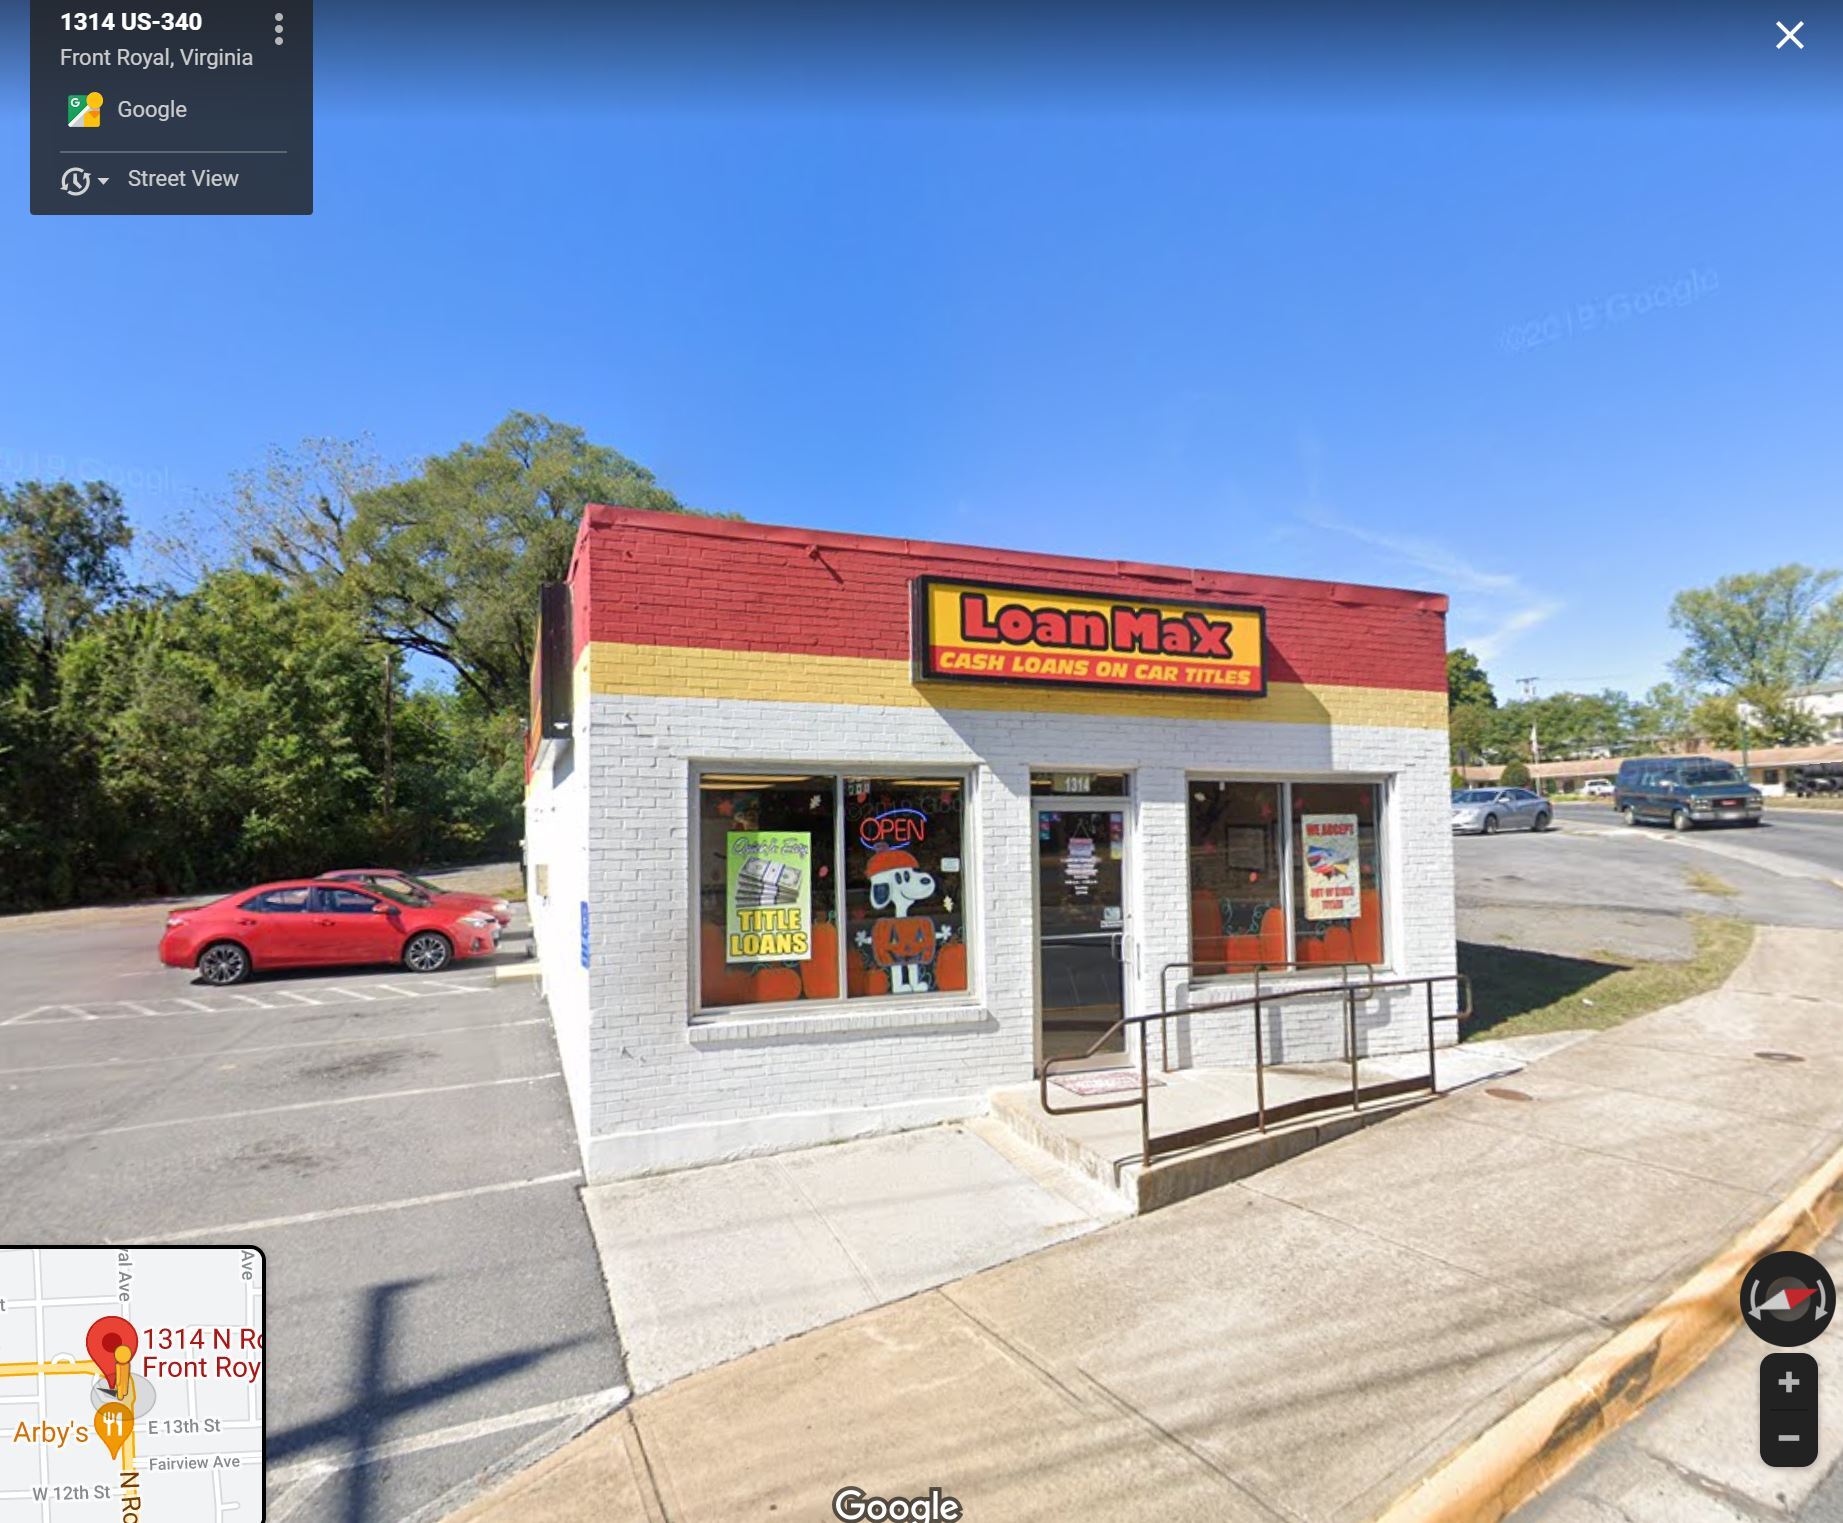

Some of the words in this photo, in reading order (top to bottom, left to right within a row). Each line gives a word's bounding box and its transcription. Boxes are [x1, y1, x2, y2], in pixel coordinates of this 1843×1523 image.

[939, 651, 1004, 672] CASH
[1011, 656, 1089, 676] LOANS
[1095, 661, 1128, 679] ON
[1134, 664, 1178, 682] CAR
[1185, 667, 1251, 685] TITLES
[1065, 776, 1090, 792] 1314
[860, 817, 926, 842] OPEN
[736, 908, 802, 932] TITLE
[730, 932, 808, 956] LOANS
